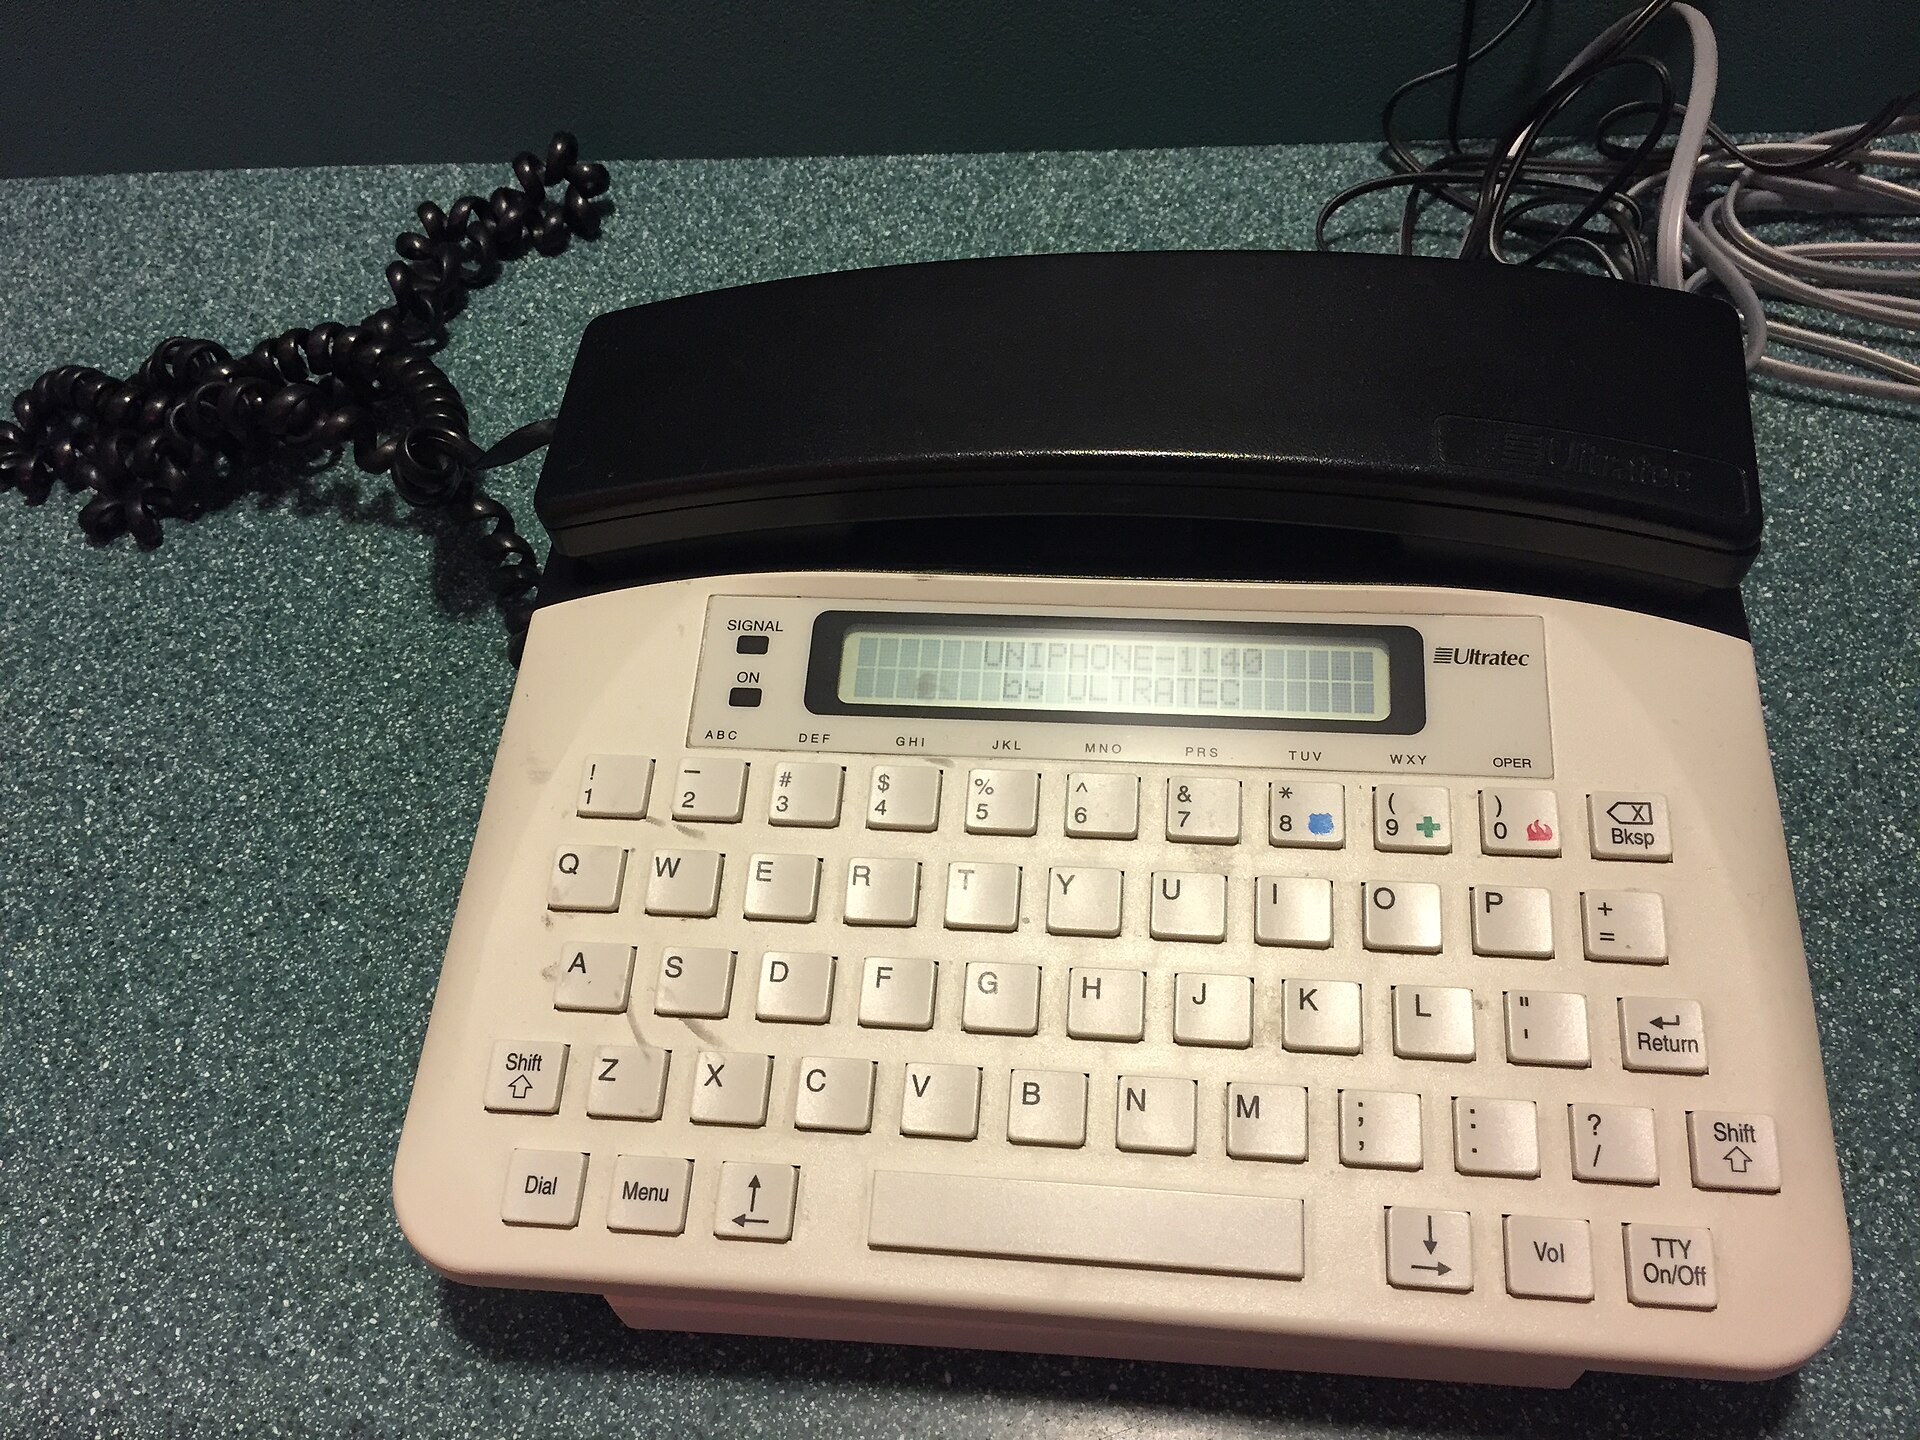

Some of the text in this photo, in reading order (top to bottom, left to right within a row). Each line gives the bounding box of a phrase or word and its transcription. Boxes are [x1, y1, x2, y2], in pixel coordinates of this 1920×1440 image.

[726, 619, 784, 632] SIGNAL
[1453, 647, 1530, 667] Ultratec
[736, 671, 760, 684] ON
[1067, 674, 1240, 705] ULTRATEC
[704, 729, 738, 741] ABC
[798, 733, 831, 744] DEF
[895, 736, 925, 747] GHI
[991, 739, 1021, 751] JKL
[1085, 742, 1122, 754] MNO
[1185, 746, 1218, 758] PRS
[1288, 750, 1322, 762] TUV
[1389, 754, 1427, 765] WXY
[589, 763, 596, 781] !
[1492, 757, 1532, 769] OPER
[778, 771, 793, 788] #
[877, 773, 890, 794] $
[974, 778, 995, 796] %
[584, 788, 593, 805] 1
[681, 791, 696, 809] 2
[775, 795, 789, 813] 3
[1176, 785, 1193, 803] &
[1388, 792, 1396, 815] (
[874, 799, 887, 816] 4
[975, 803, 989, 821] 5
[1074, 806, 1088, 824] 6
[1494, 794, 1503, 818] )
[1177, 810, 1191, 828] 7
[1279, 814, 1293, 832] 8
[1385, 818, 1399, 837] 9
[1611, 827, 1655, 850] Bksp
[558, 852, 580, 875] Q
[655, 856, 682, 879] W
[755, 860, 774, 883] E
[852, 864, 871, 887] R
[957, 868, 975, 891] T
[1056, 873, 1076, 896] Y
[1162, 878, 1181, 901] U
[1372, 886, 1396, 910] O
[1485, 891, 1504, 914] P
[567, 951, 587, 974] A
[664, 955, 684, 979] S
[769, 960, 790, 983] D
[875, 966, 894, 989] F
[977, 971, 999, 995] G
[1081, 976, 1102, 1000] H
[1192, 982, 1207, 1005] J
[1299, 987, 1319, 1012] K
[1414, 993, 1432, 1018] L
[1637, 1031, 1699, 1053] Return
[505, 1052, 543, 1073] Shift
[598, 1058, 619, 1082] Z
[703, 1063, 725, 1088] X
[806, 1068, 827, 1093] C
[911, 1073, 932, 1098] V
[1021, 1081, 1041, 1106] B
[1126, 1087, 1146, 1112] N
[1236, 1094, 1260, 1119] M
[1587, 1113, 1602, 1136] ?
[1713, 1121, 1757, 1144] Shift
[1592, 1144, 1602, 1168] /
[524, 1175, 558, 1196] Dial
[622, 1180, 670, 1203] Menu
[1533, 1240, 1565, 1263] Vol
[1650, 1237, 1692, 1260] TTY
[1643, 1262, 1707, 1286] On/Off
